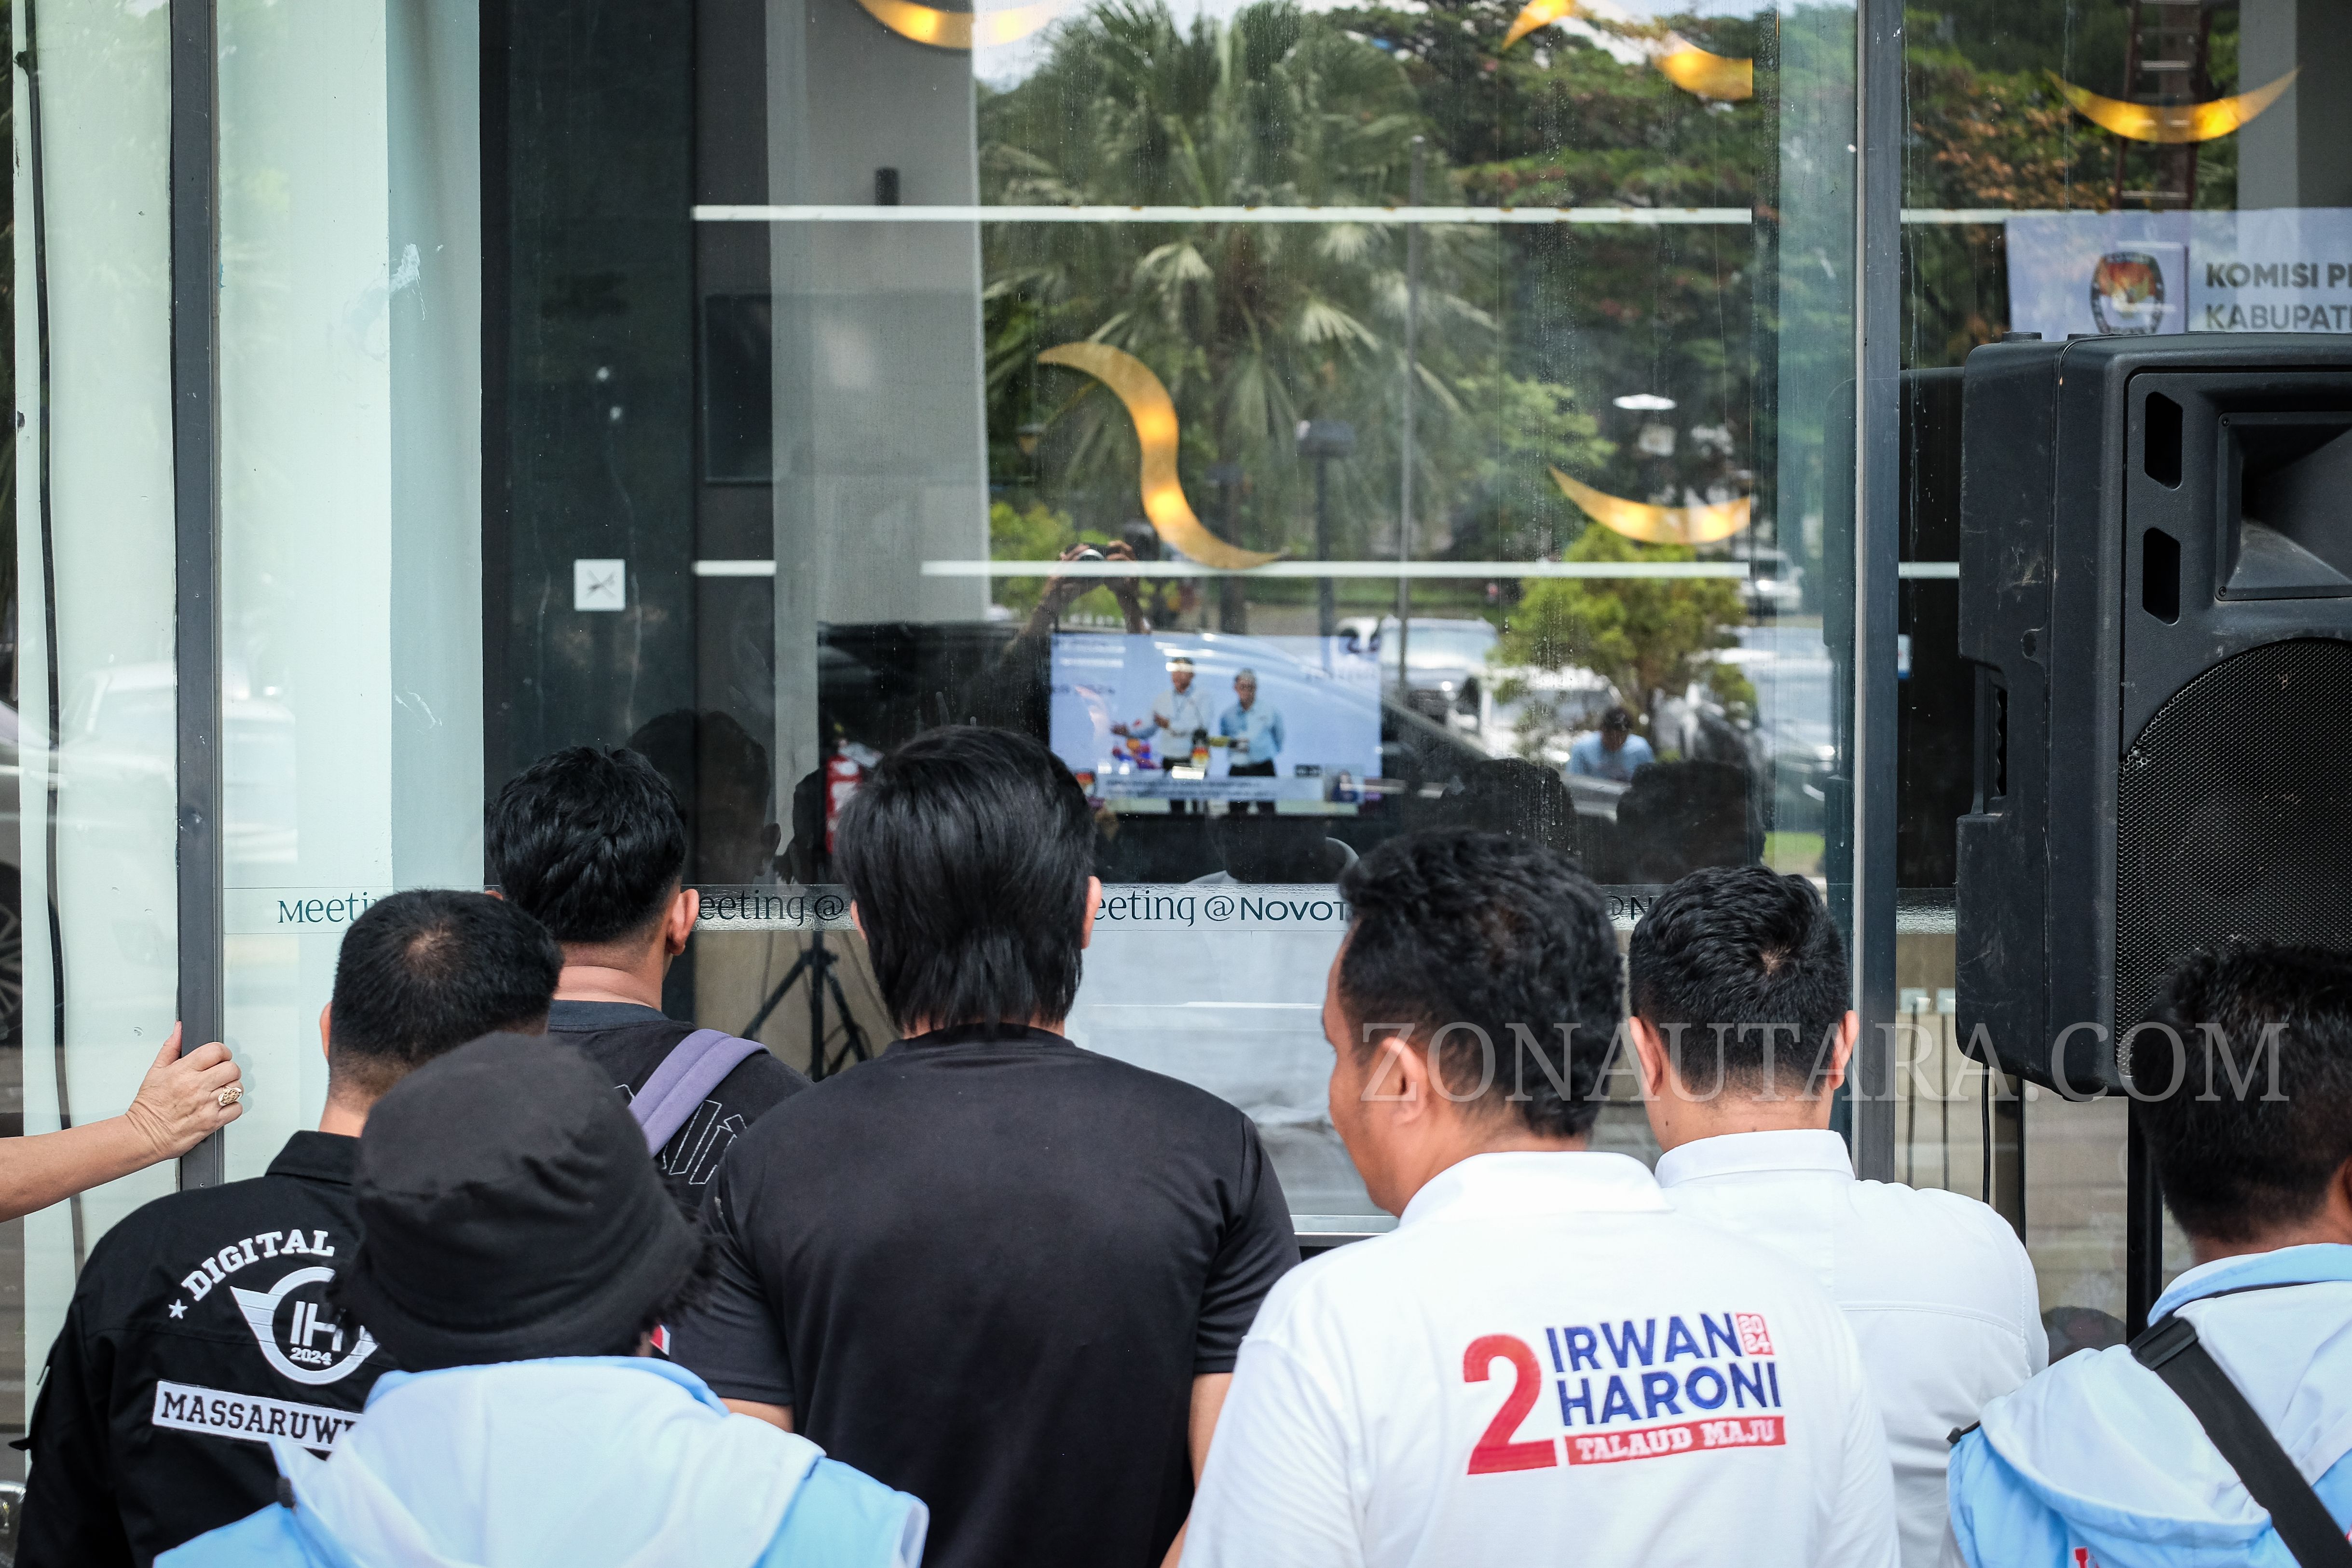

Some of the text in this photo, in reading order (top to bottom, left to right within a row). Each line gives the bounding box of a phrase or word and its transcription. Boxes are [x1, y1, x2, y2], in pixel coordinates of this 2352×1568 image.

[2206, 262, 2319, 288] KOMISI
[2206, 304, 2352, 330] KABUPAT
[277, 892, 381, 923] Meeti
[698, 890, 806, 927] eeting
[1094, 890, 1197, 927] eeting
[181, 1229, 335, 1301] DIGITAL
[289, 1347, 332, 1366] 2024
[1545, 1312, 1743, 1373] IRWAN
[1463, 1333, 1558, 1475] 2
[1556, 1362, 1781, 1427] HARONI
[1575, 1419, 1775, 1461] TALAUD MAJU
